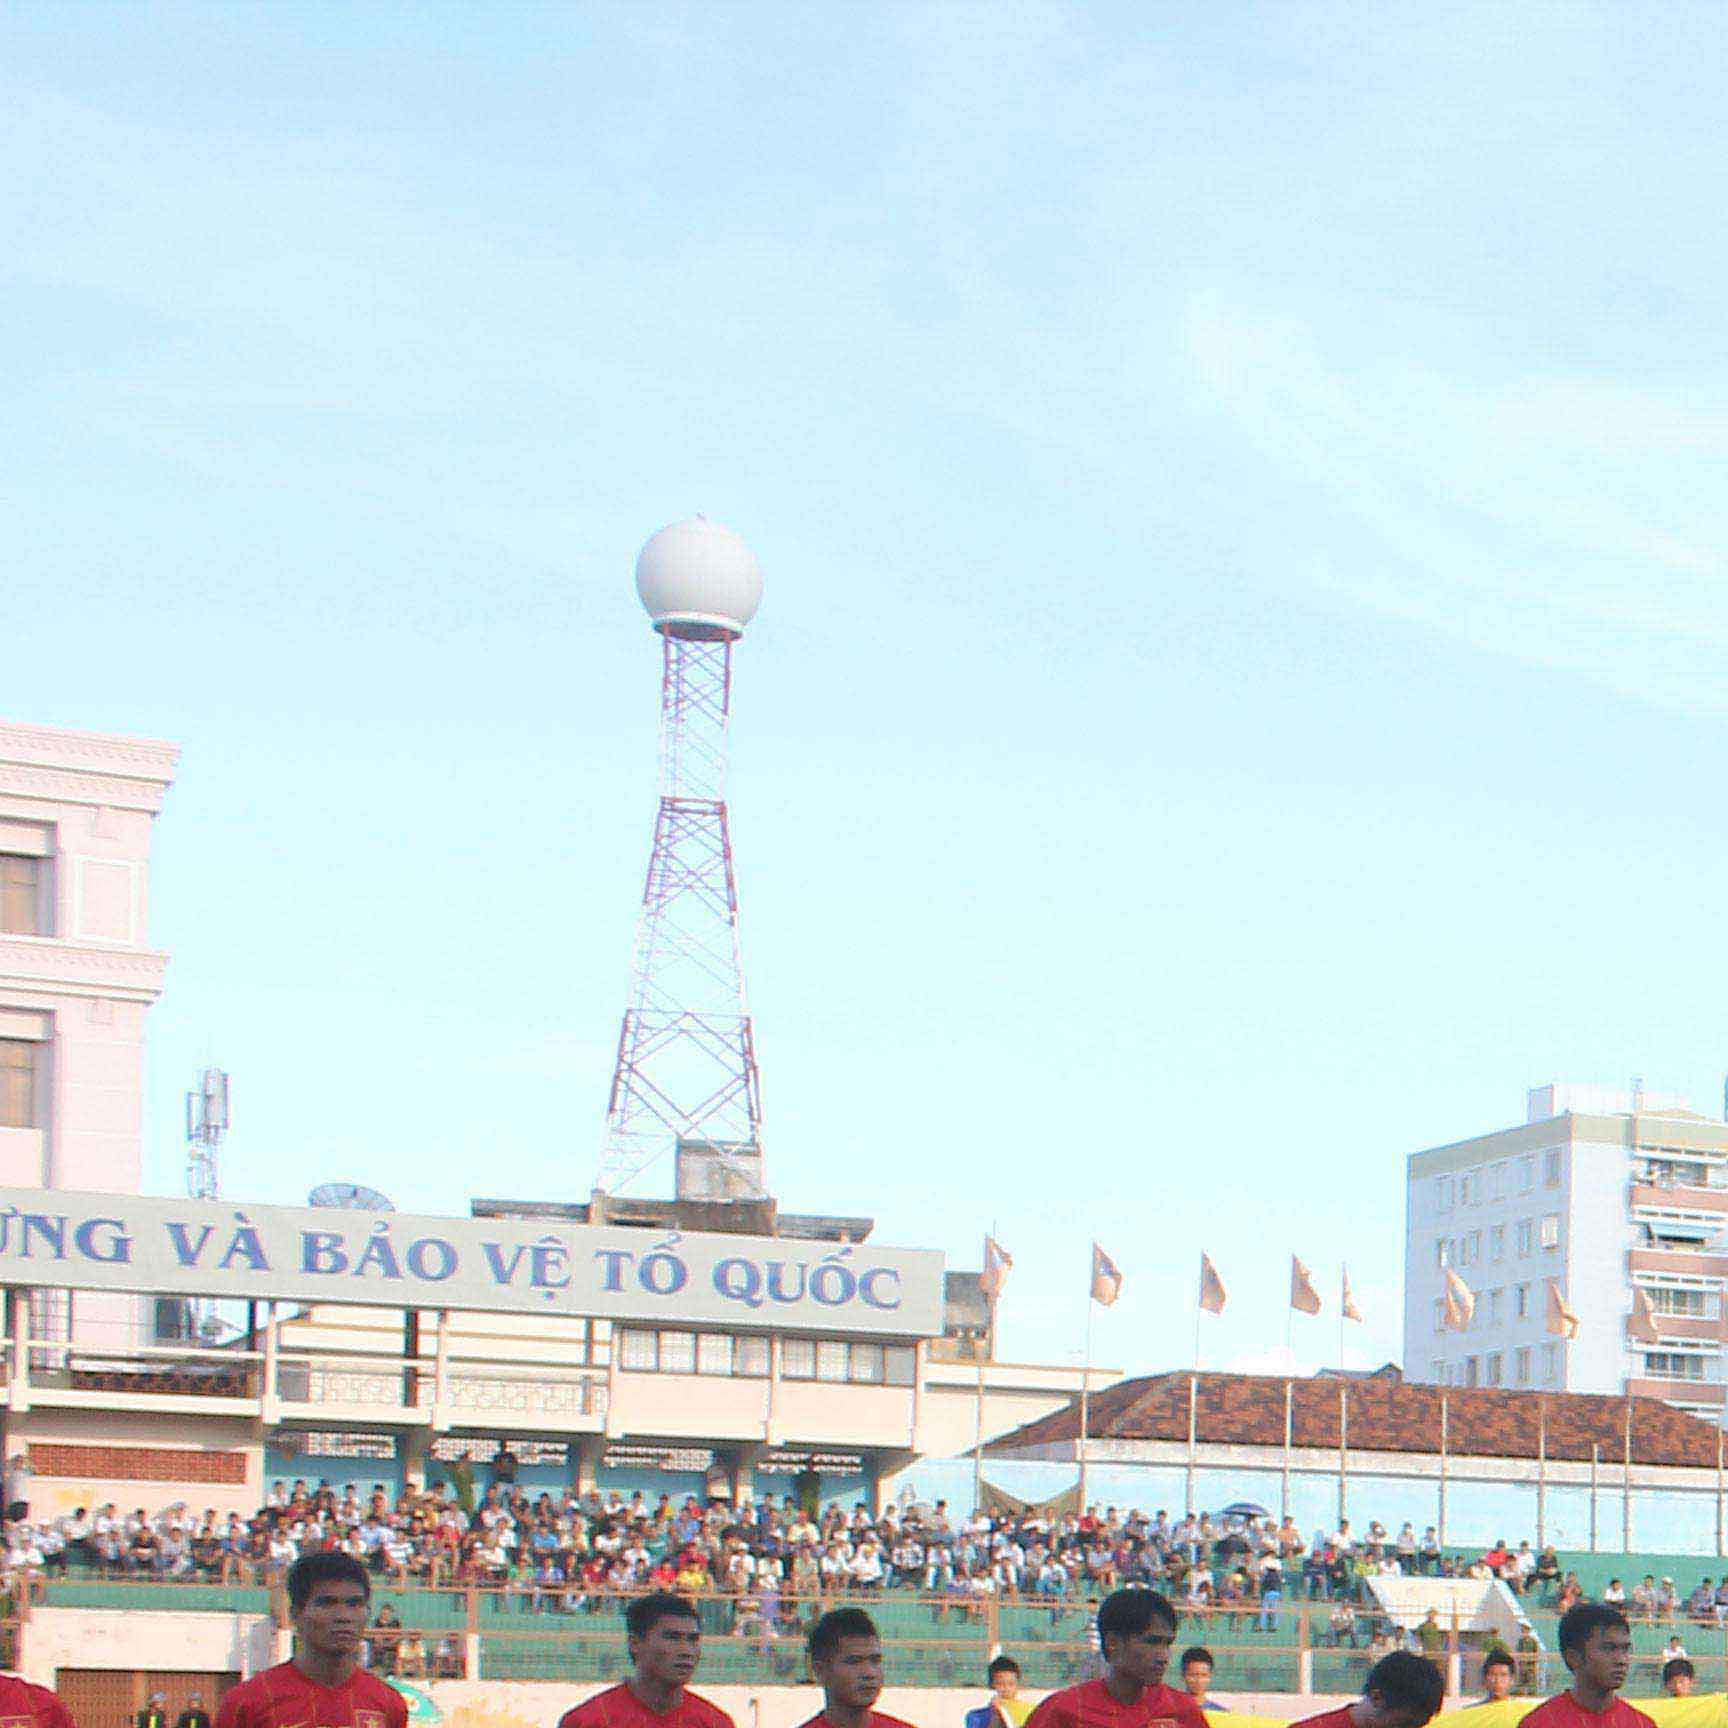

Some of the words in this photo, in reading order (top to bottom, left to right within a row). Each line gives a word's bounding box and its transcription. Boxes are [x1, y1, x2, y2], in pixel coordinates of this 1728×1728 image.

[163, 1211, 273, 1270] VÀ
[300, 1220, 459, 1281] BẢO
[478, 1233, 572, 1300] VỆ
[593, 1232, 688, 1296] TỔ
[712, 1246, 903, 1309] QUỐC
